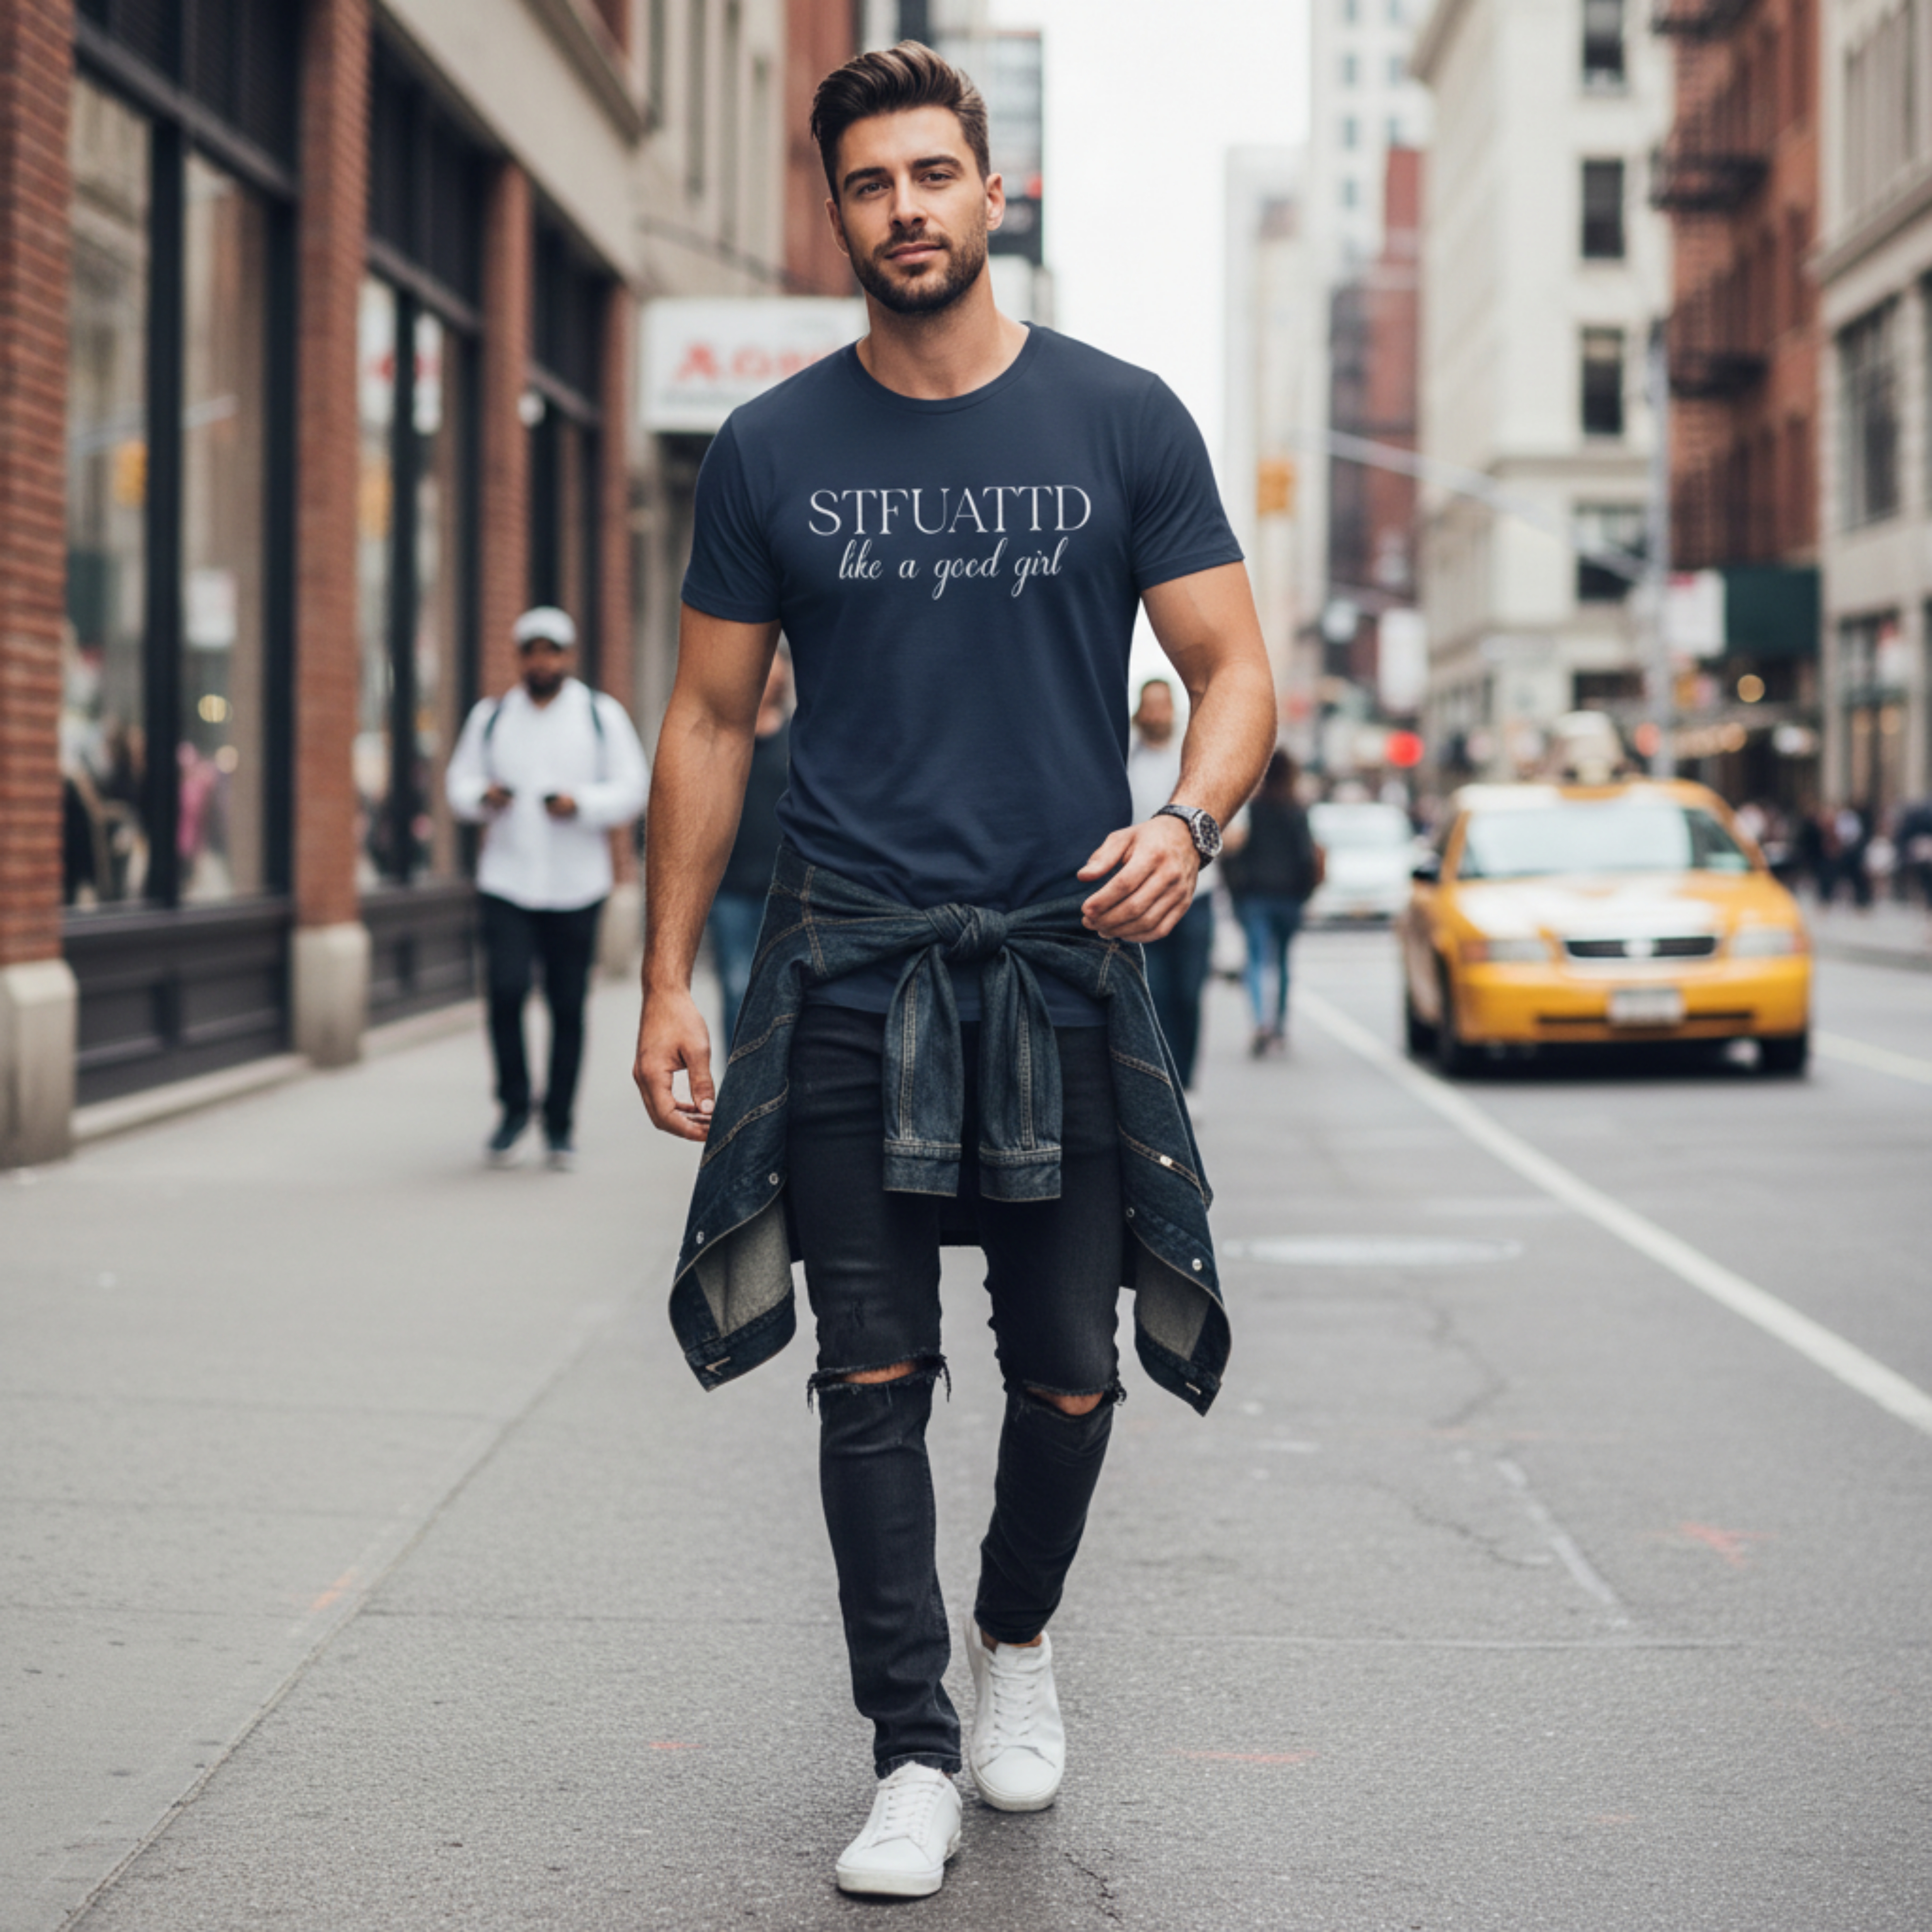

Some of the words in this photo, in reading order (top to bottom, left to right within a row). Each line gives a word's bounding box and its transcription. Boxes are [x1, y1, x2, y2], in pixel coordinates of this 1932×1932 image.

[809, 485, 1091, 536] STFUATTD
[839, 538, 882, 579] like
[898, 559, 919, 579] a
[932, 537, 1008, 600] good
[1010, 536, 1068, 597] girl
